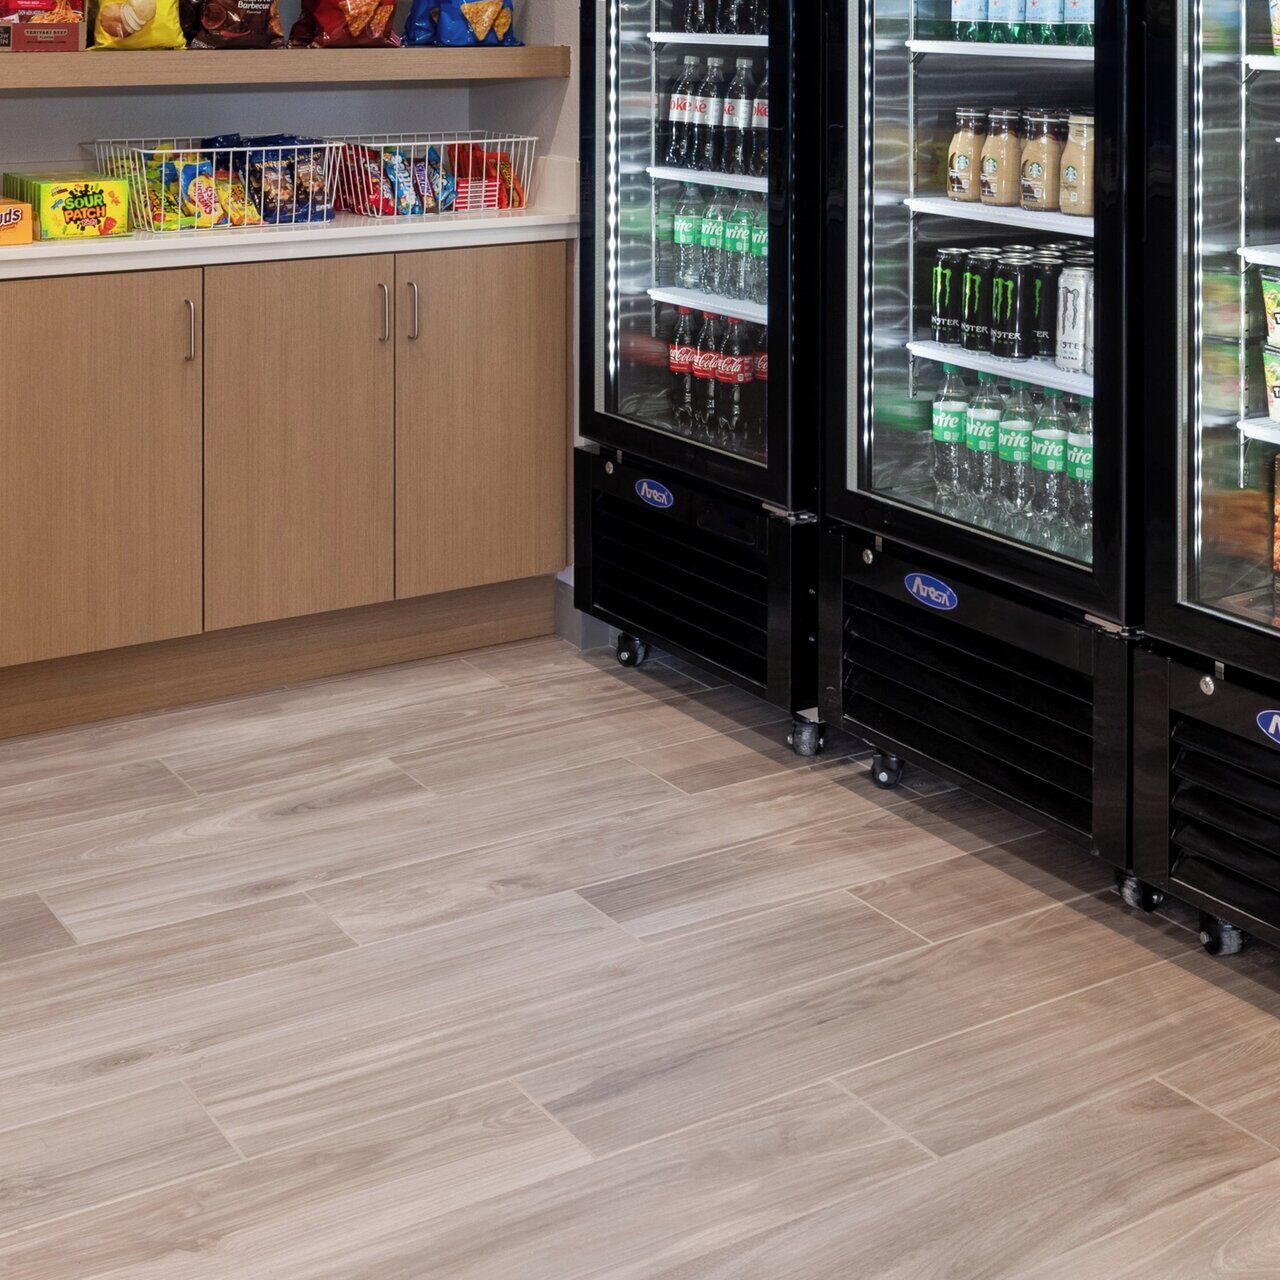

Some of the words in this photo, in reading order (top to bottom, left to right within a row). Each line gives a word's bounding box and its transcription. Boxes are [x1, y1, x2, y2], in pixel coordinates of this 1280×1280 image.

[64, 193, 104, 210] SOUR
[64, 207, 106, 223] PATCH
[999, 432, 1030, 448] prite
[1032, 440, 1063, 457] prite
